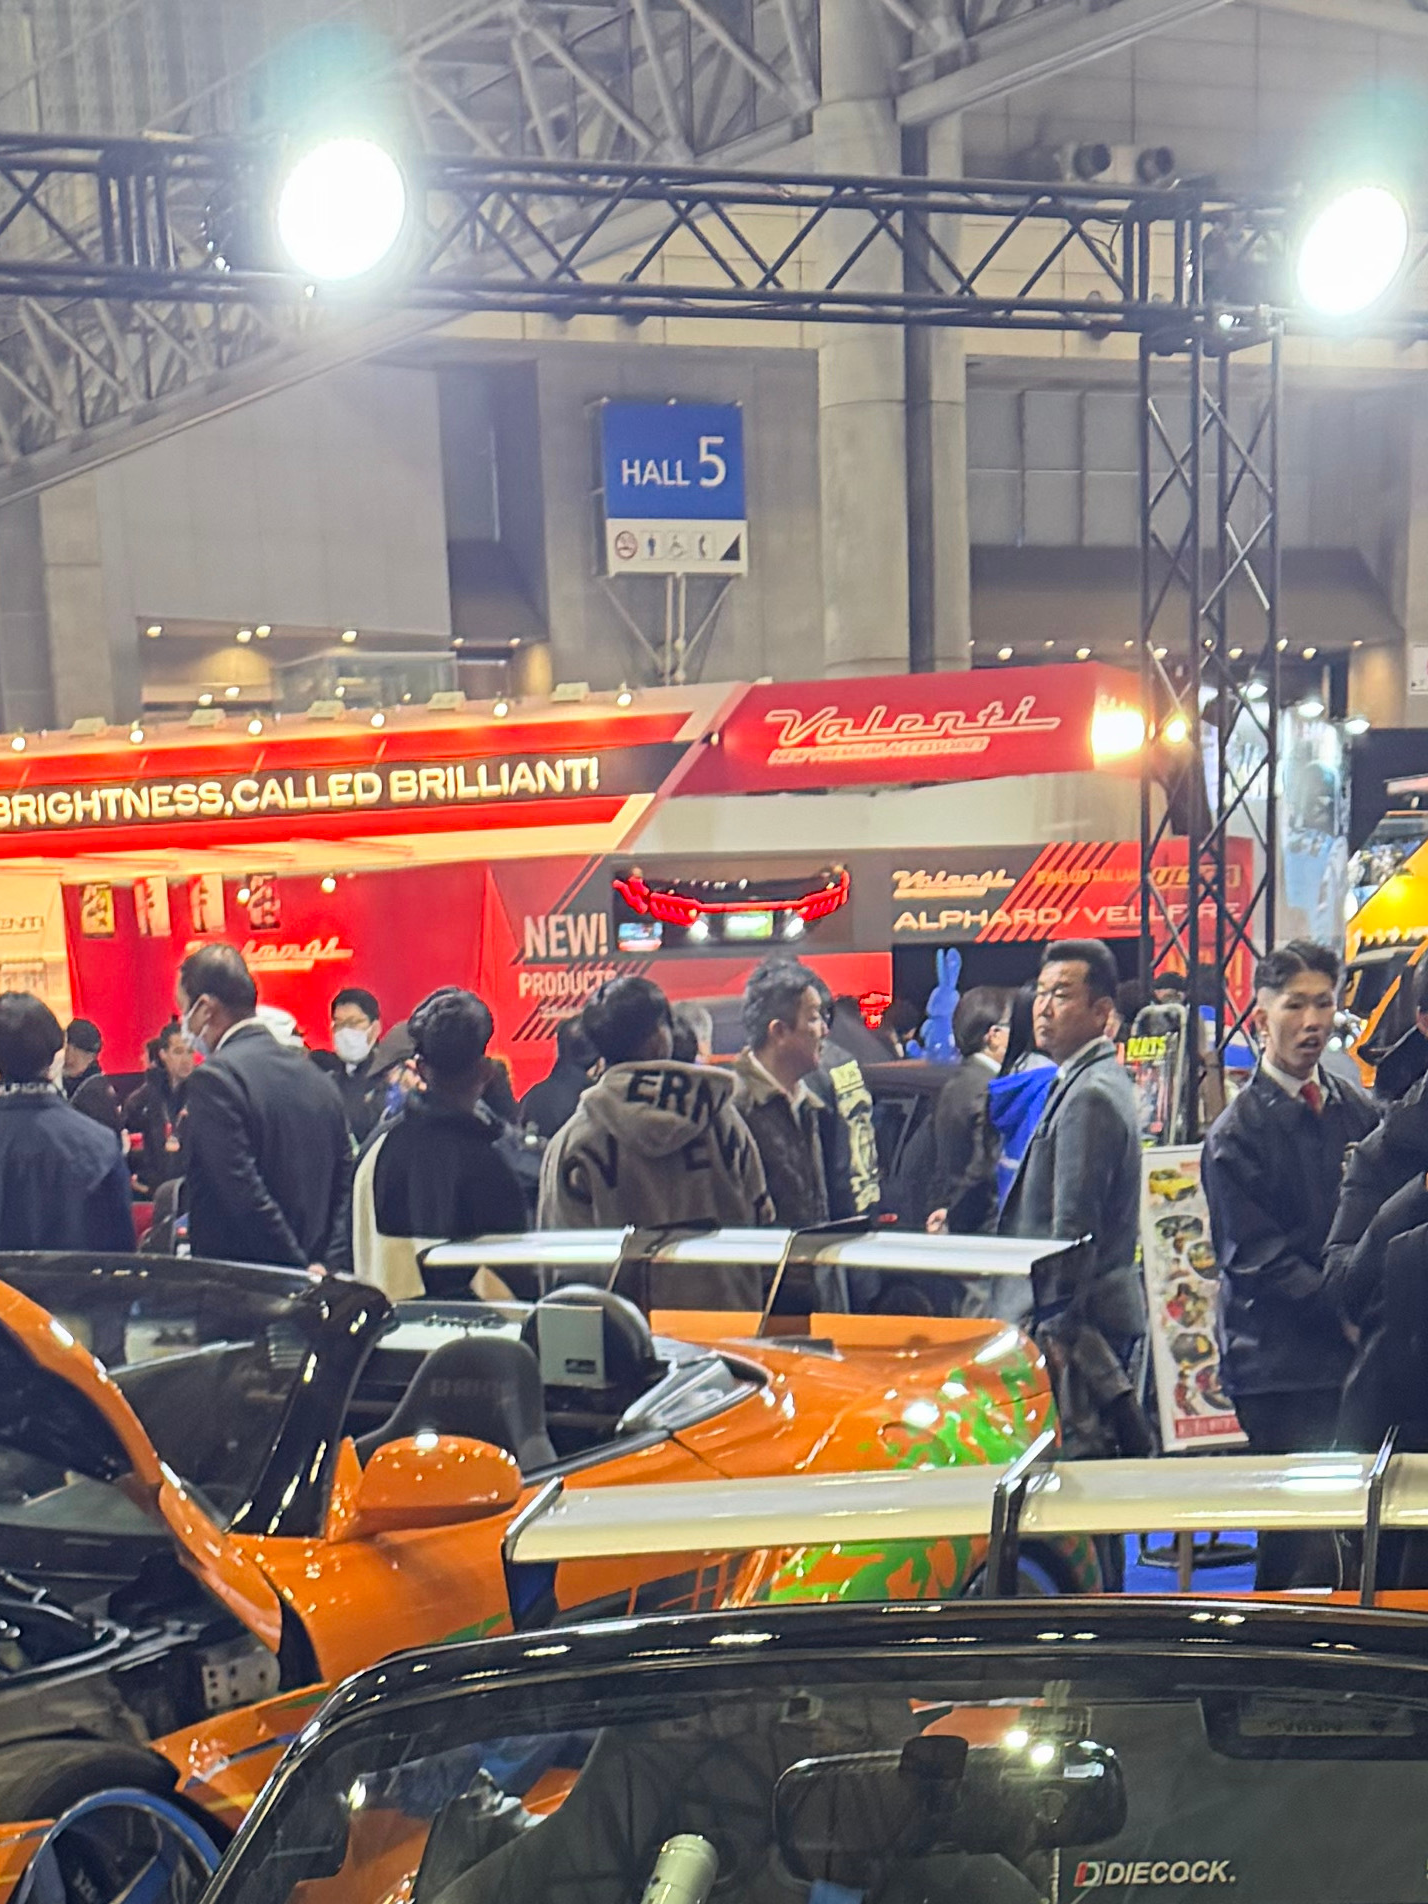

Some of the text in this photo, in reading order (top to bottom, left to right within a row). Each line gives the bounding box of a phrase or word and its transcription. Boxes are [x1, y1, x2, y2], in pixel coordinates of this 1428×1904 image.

[621, 436, 726, 487] HALL 5
[765, 696, 1061, 746] Valenti
[390, 757, 601, 801] BRILLIANT!
[523, 912, 609, 958] NEW!
